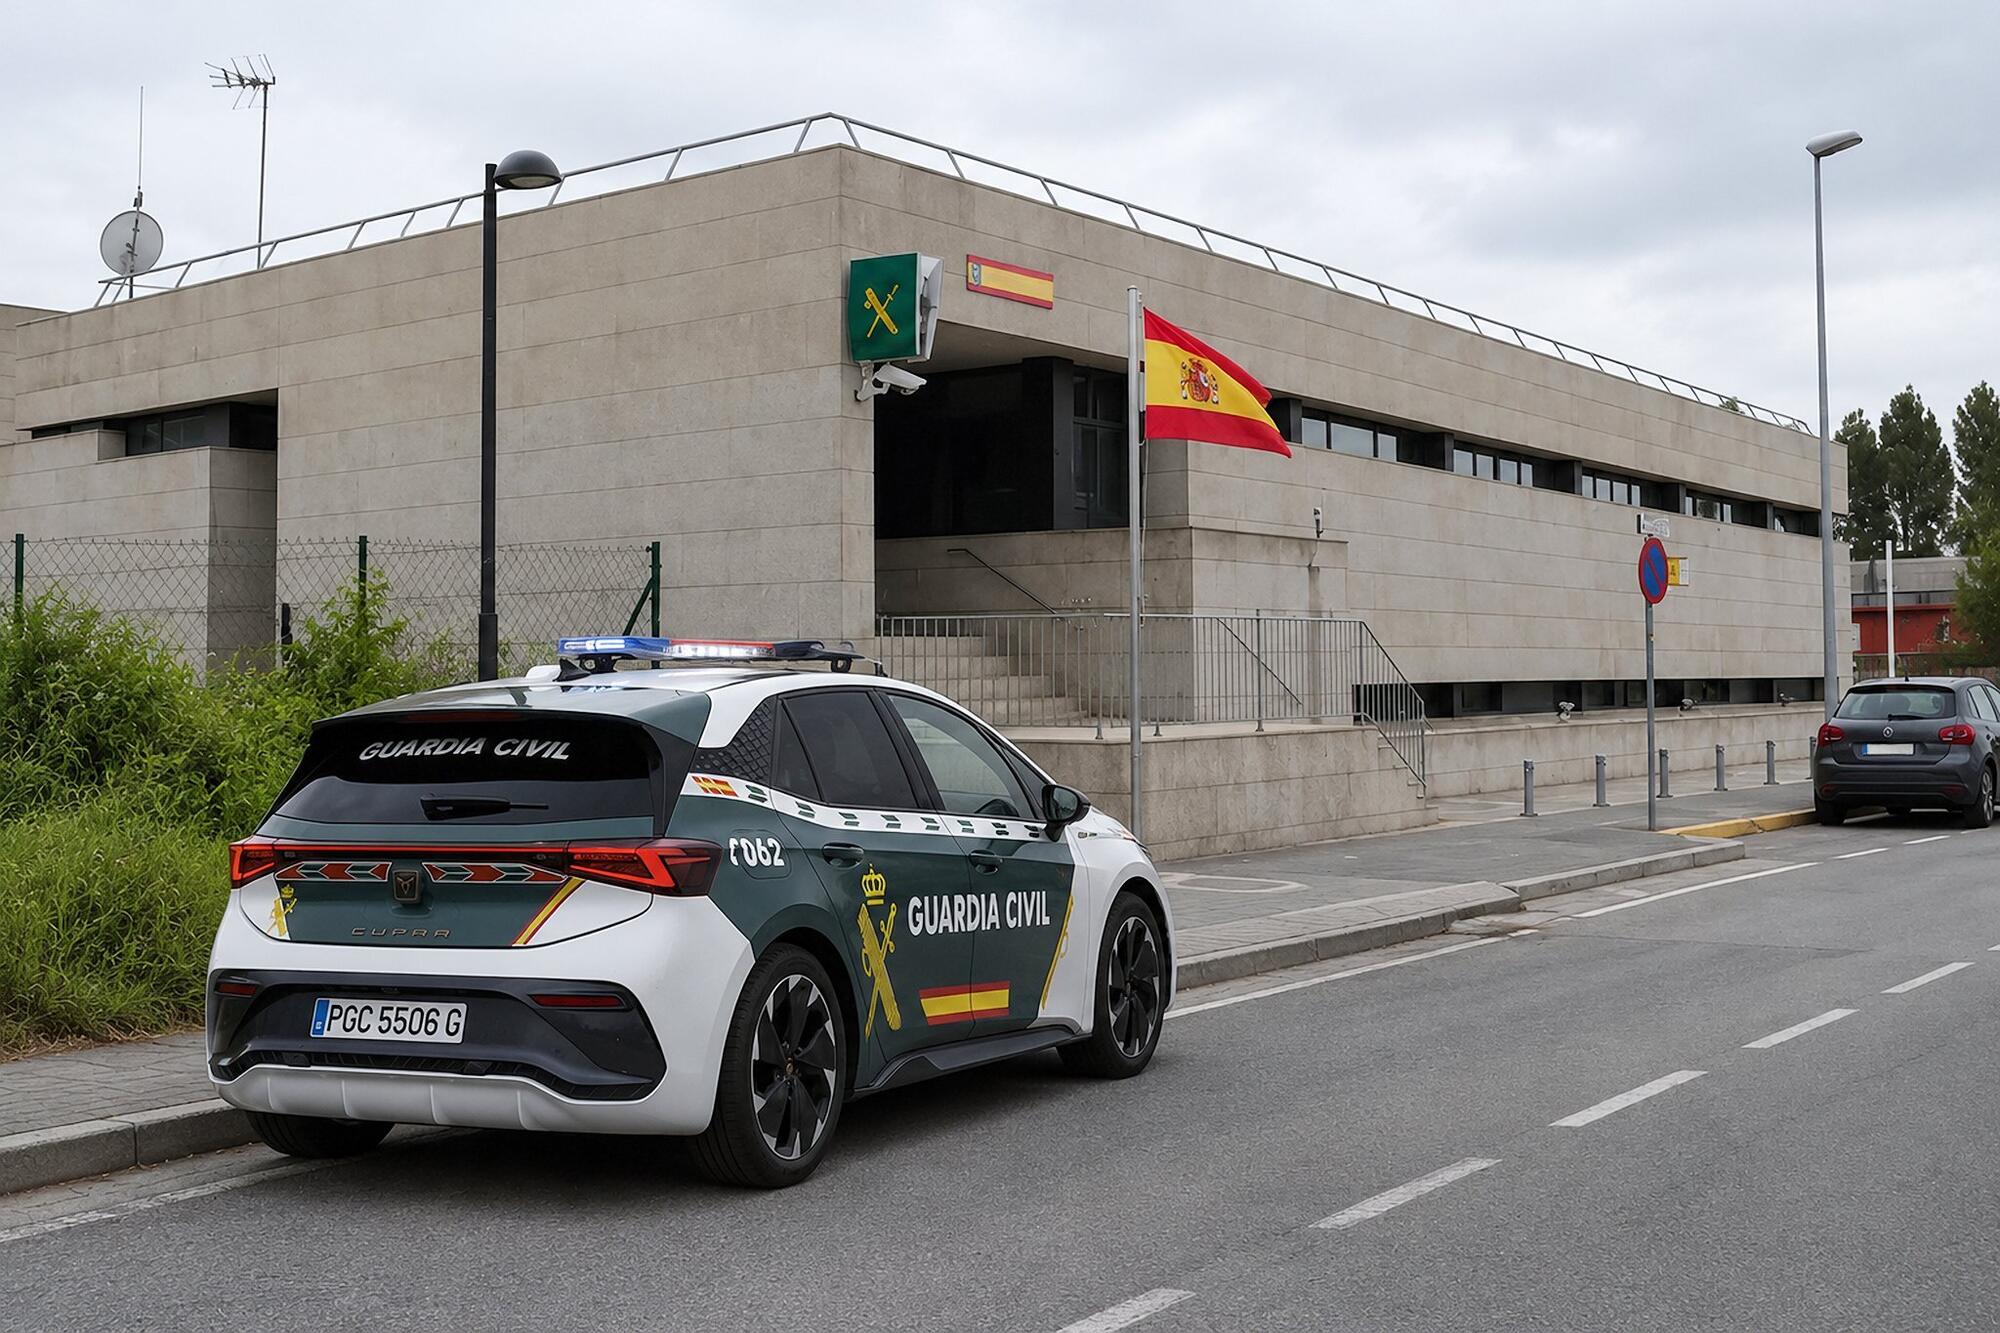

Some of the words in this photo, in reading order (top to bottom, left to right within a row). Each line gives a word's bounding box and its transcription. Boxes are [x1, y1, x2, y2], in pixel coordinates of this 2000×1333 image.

[359, 738, 487, 761] GUARDIA
[494, 739, 571, 760] CIVIL
[908, 893, 1000, 936] GUARDIA
[1006, 890, 1050, 929] CIVIL
[351, 927, 451, 938] CUPRA
[327, 1004, 373, 1033] PGC
[378, 1006, 440, 1036] 5506
[445, 1008, 462, 1037] G
